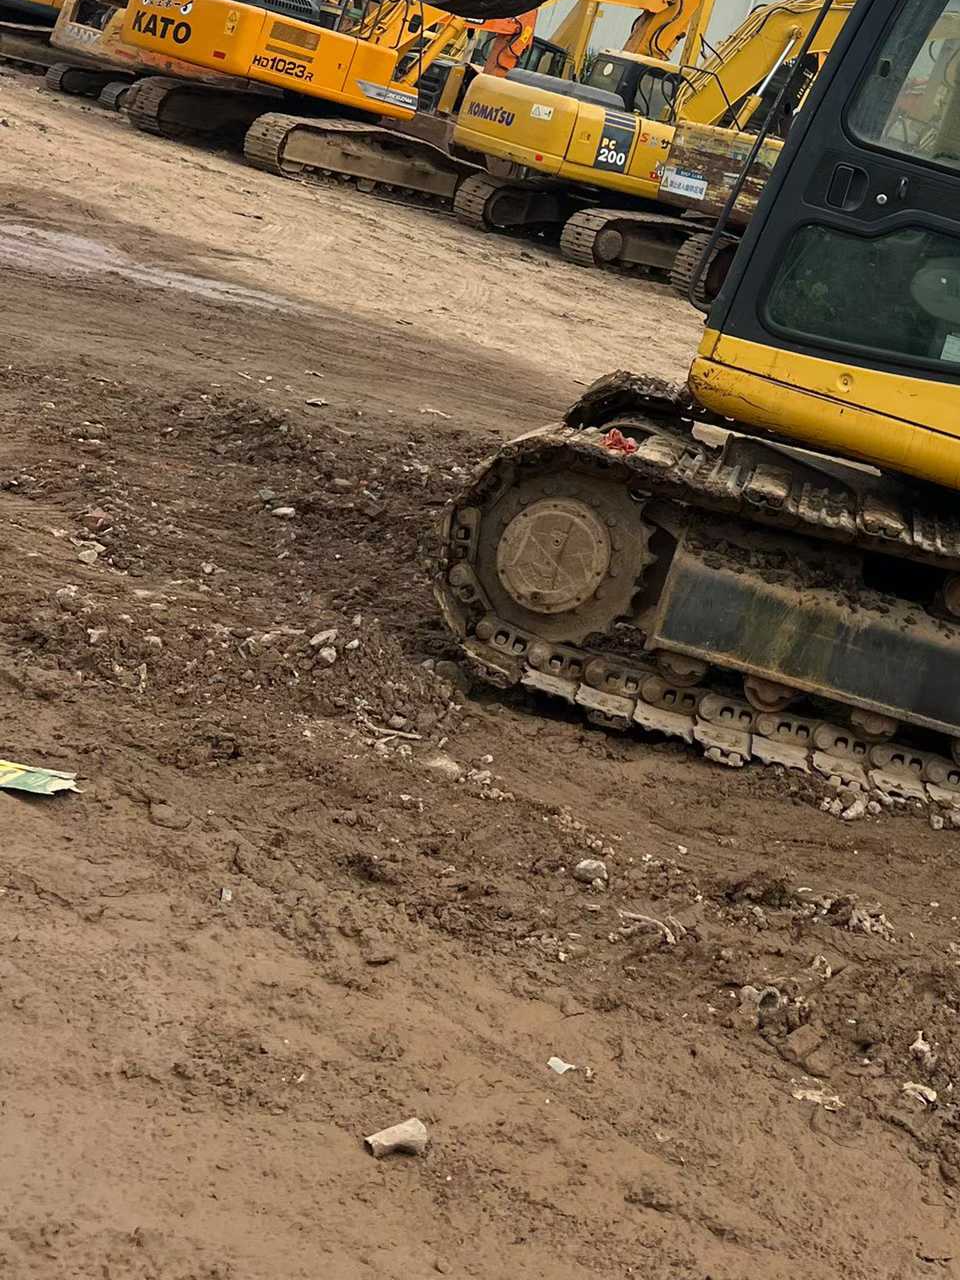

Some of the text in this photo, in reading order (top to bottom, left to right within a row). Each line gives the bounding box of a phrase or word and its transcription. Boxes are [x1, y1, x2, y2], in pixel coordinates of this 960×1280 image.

[132, 10, 192, 45] KATO
[467, 101, 516, 127] KOMATSU
[601, 137, 617, 149] PC
[598, 148, 626, 166] 200
